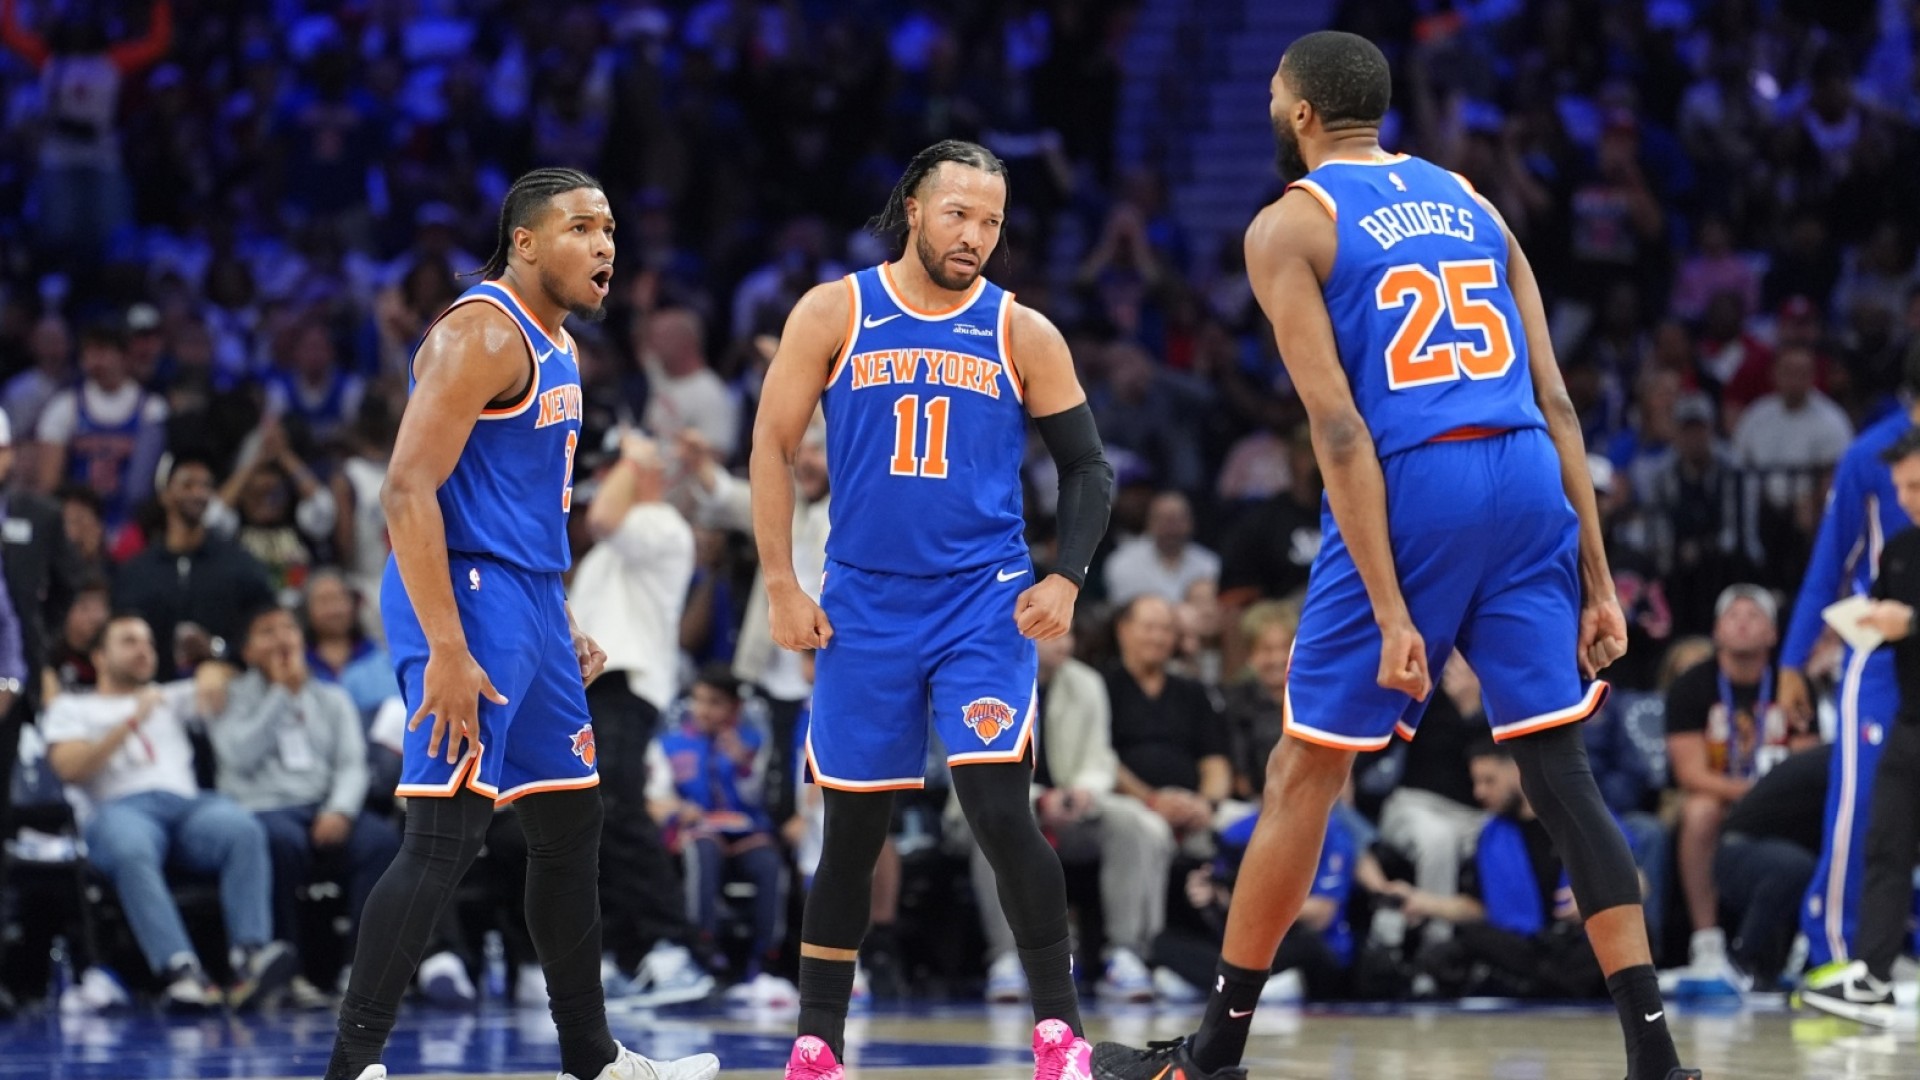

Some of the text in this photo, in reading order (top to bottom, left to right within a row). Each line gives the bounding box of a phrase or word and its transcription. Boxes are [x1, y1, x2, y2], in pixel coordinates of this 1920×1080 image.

[1359, 201, 1475, 250] BRIDGES
[1375, 259, 1516, 390] 25
[851, 348, 1002, 400] NEW YORK
[890, 394, 950, 479] 11
[562, 429, 578, 513] 2
[966, 703, 1012, 724] KNICKS
